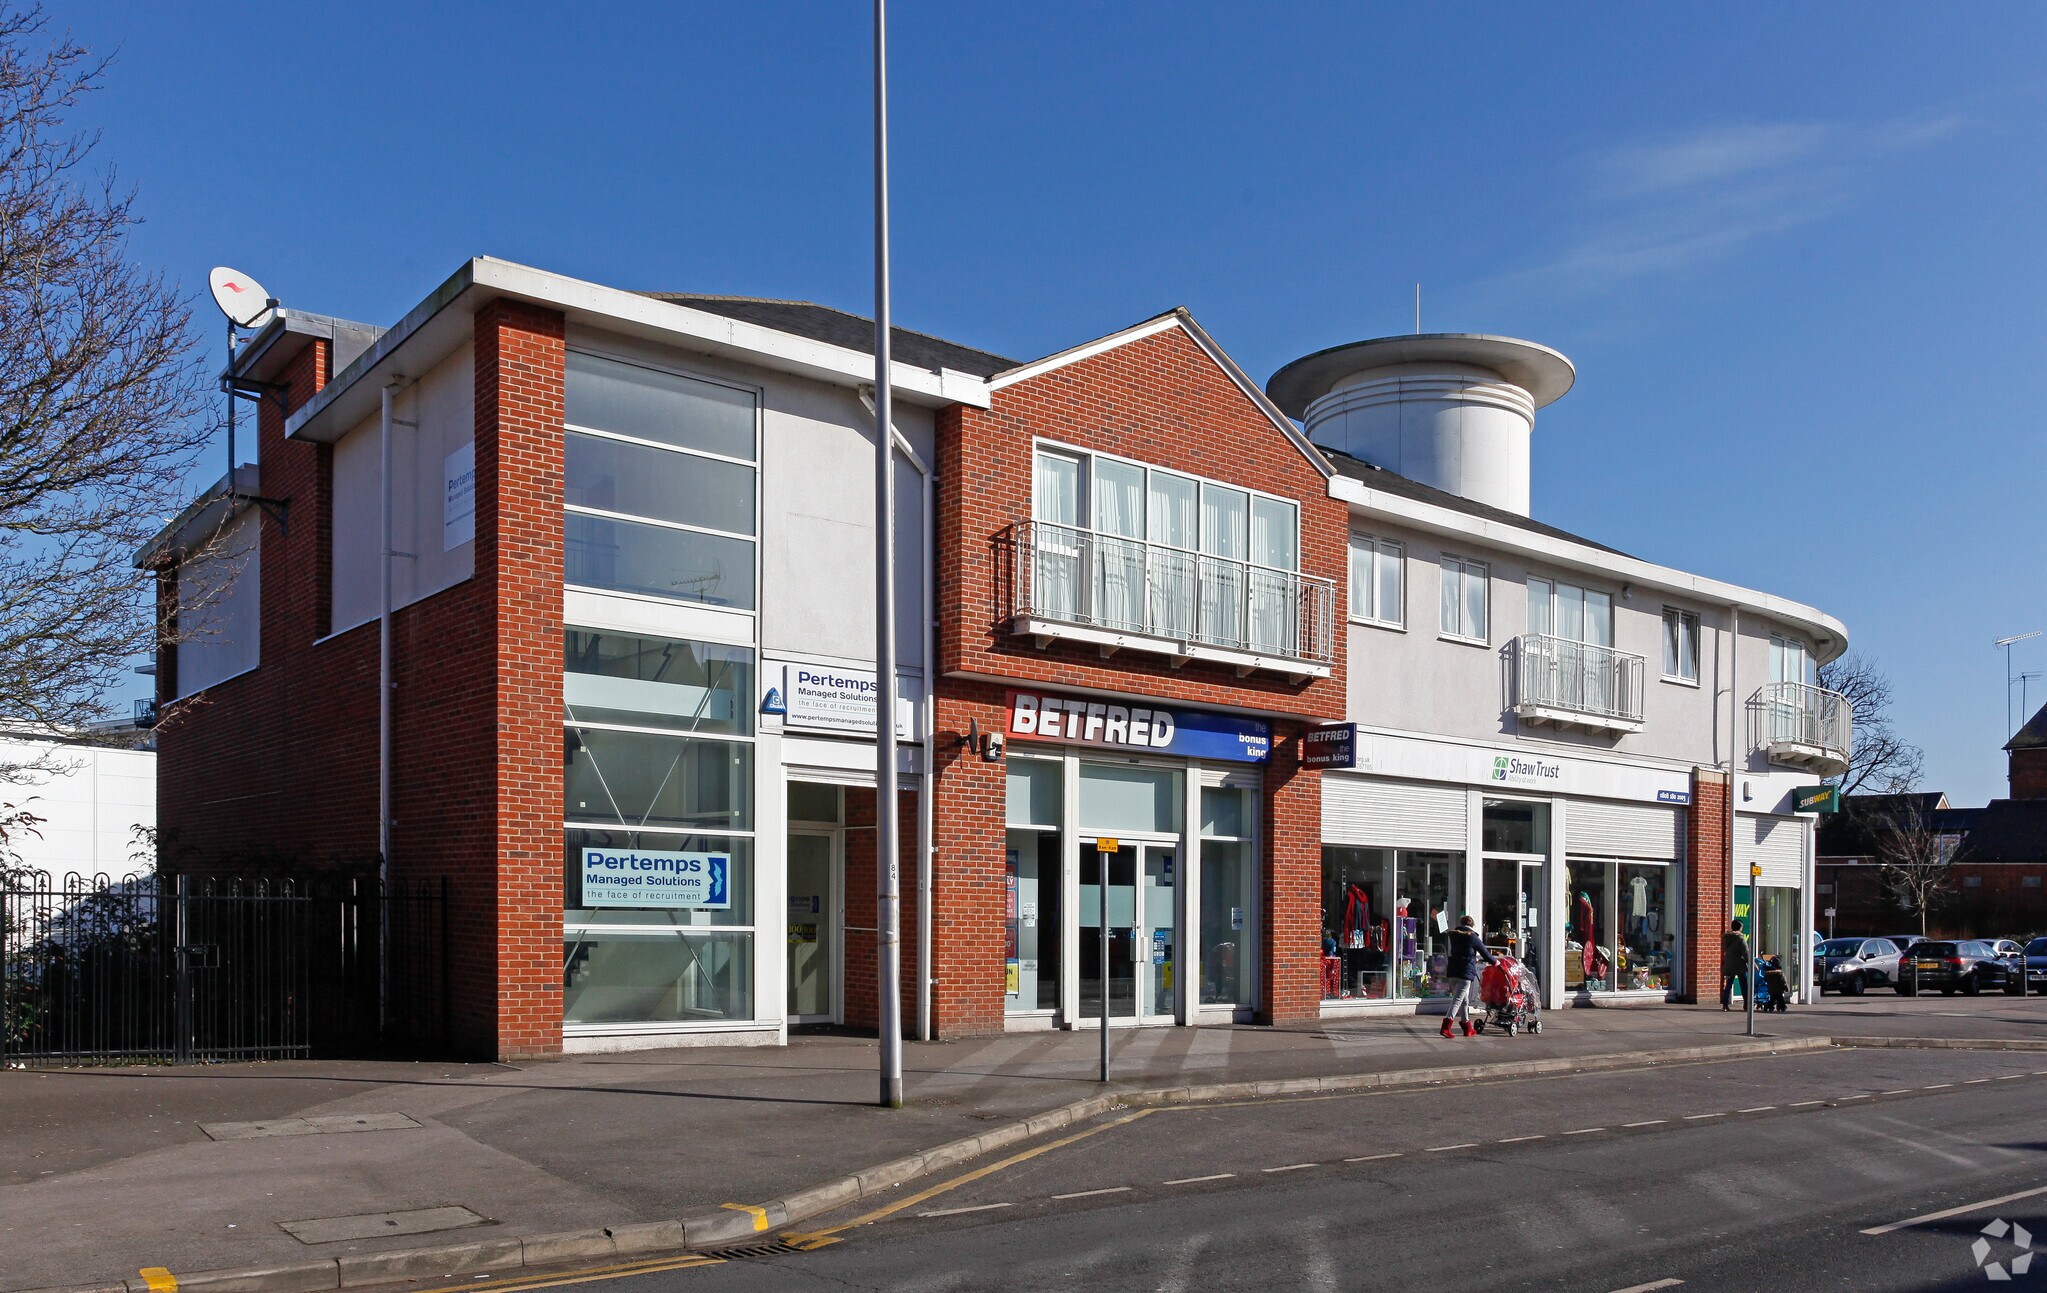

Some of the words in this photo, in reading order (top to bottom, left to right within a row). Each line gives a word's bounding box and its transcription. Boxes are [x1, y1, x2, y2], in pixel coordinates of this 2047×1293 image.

[448, 469, 475, 491] Pertemp
[798, 671, 877, 692] Pertemps
[798, 687, 837, 700] Managed
[839, 691, 877, 703] Solutions
[812, 701, 827, 709] face
[839, 704, 876, 713] recruitmen
[1012, 694, 1176, 748] BETFRED
[1254, 722, 1266, 733] the
[1238, 732, 1267, 745] bonus
[1307, 730, 1350, 742] BETFRED
[1247, 745, 1266, 759] king
[1339, 744, 1349, 753] the
[1306, 755, 1330, 763] bonus
[1332, 753, 1350, 763] king
[1509, 758, 1536, 775] Shaw
[1536, 761, 1560, 778] Trust
[1799, 790, 1832, 808] SUBWAY
[587, 852, 701, 875] Pertemps
[586, 874, 642, 886] Managed
[646, 876, 701, 887] Solutions
[587, 890, 603, 898] the
[607, 890, 628, 899] face
[632, 891, 642, 899] of
[645, 892, 700, 900] recruitment
[1734, 903, 1750, 917] WAY
